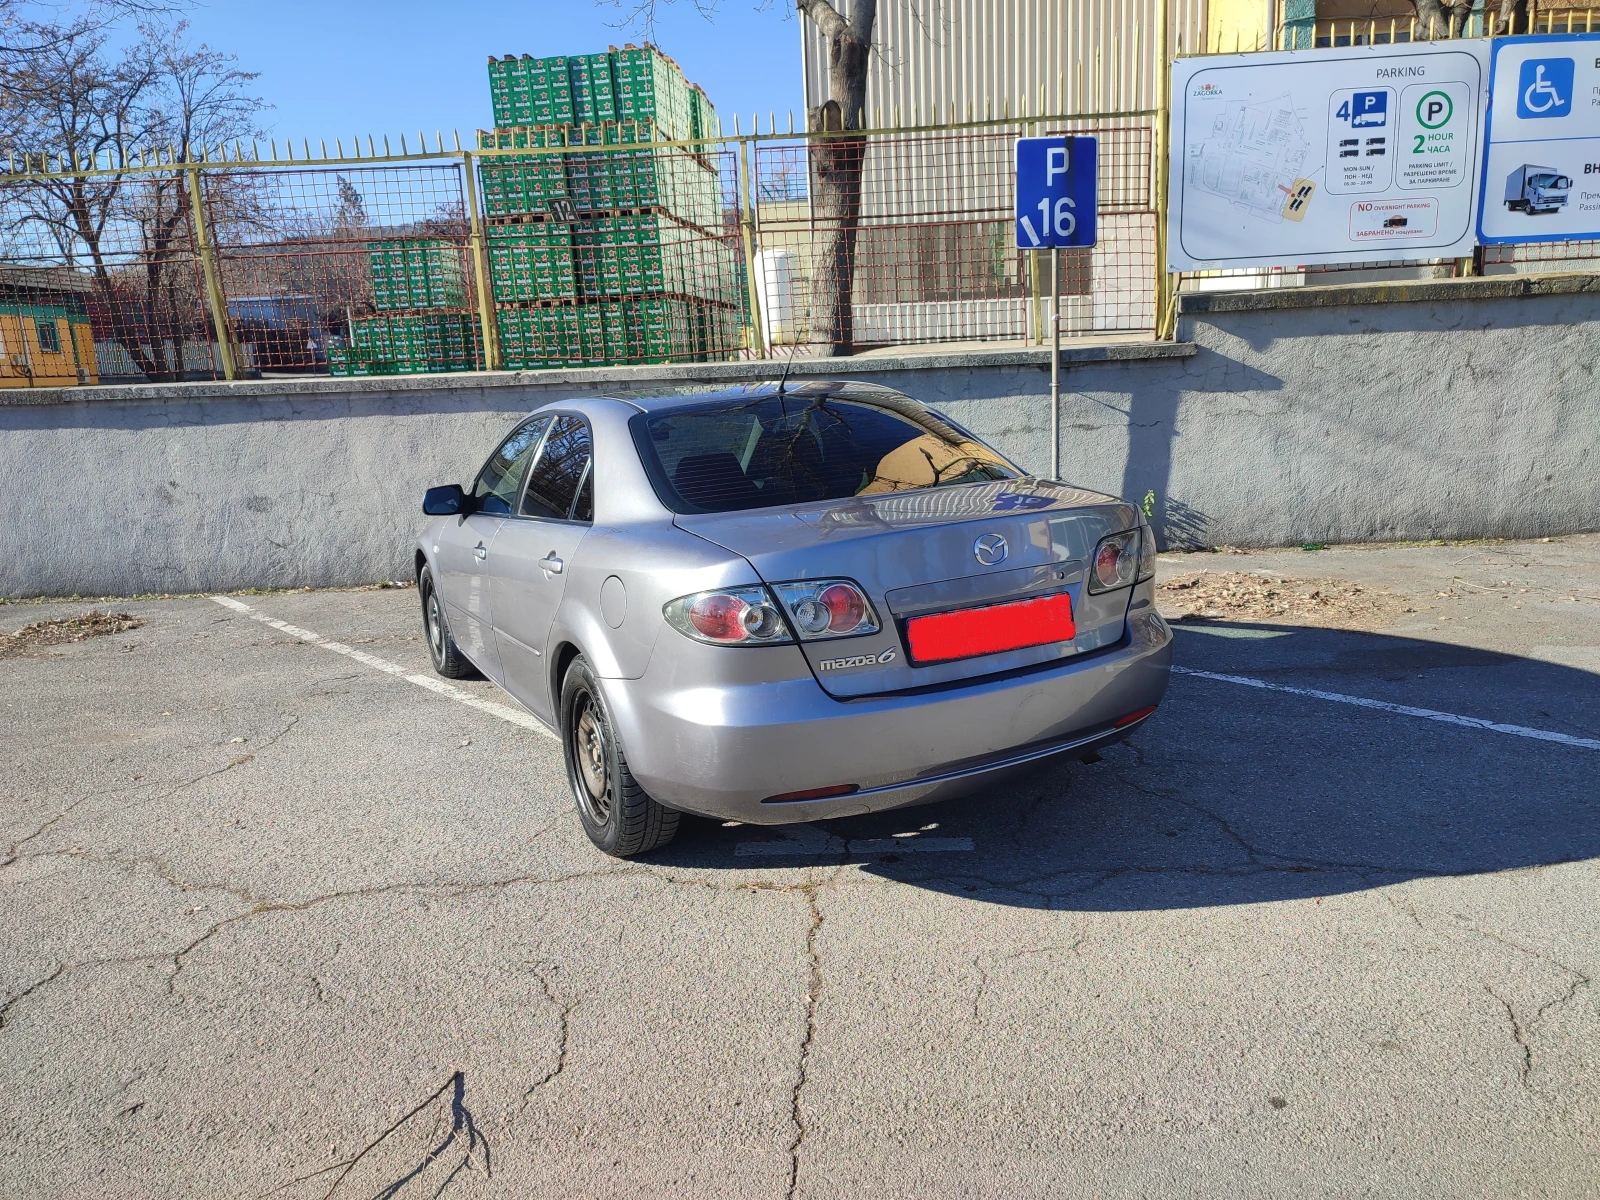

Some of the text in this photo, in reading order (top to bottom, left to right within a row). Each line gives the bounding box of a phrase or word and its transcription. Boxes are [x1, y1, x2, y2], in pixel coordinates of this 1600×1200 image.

[1376, 66, 1425, 78] PARKING
[1336, 100, 1350, 121] 4
[1365, 96, 1376, 110] P
[1428, 102, 1442, 121] P
[1413, 134, 1425, 154] 2
[1428, 133, 1454, 141] HOUR
[1427, 145, 1450, 153] ЧАСА
[1047, 147, 1069, 186] P
[1358, 203, 1373, 211] NO
[1038, 197, 1076, 236] 16
